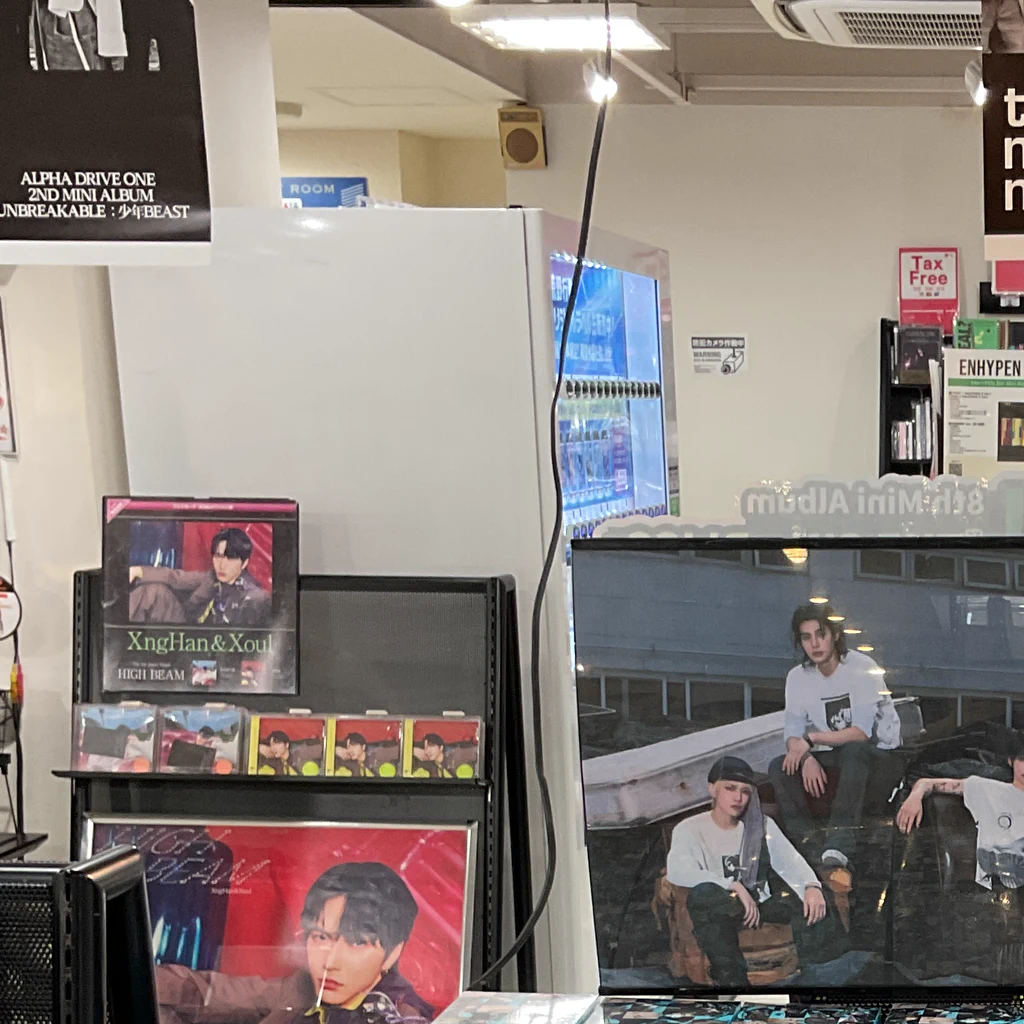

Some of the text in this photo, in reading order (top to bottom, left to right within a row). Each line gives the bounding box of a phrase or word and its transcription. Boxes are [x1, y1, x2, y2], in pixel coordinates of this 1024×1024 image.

[20, 171, 156, 186] ALPHA DRIVE ONE
[28, 188, 154, 202] 2ND MINI ALBUM
[290, 184, 335, 195] ROOM
[911, 255, 943, 271] Tax
[909, 271, 948, 285] Free
[959, 359, 1021, 377] ENHYPEN
[118, 668, 185, 681] HIGH BEAM
